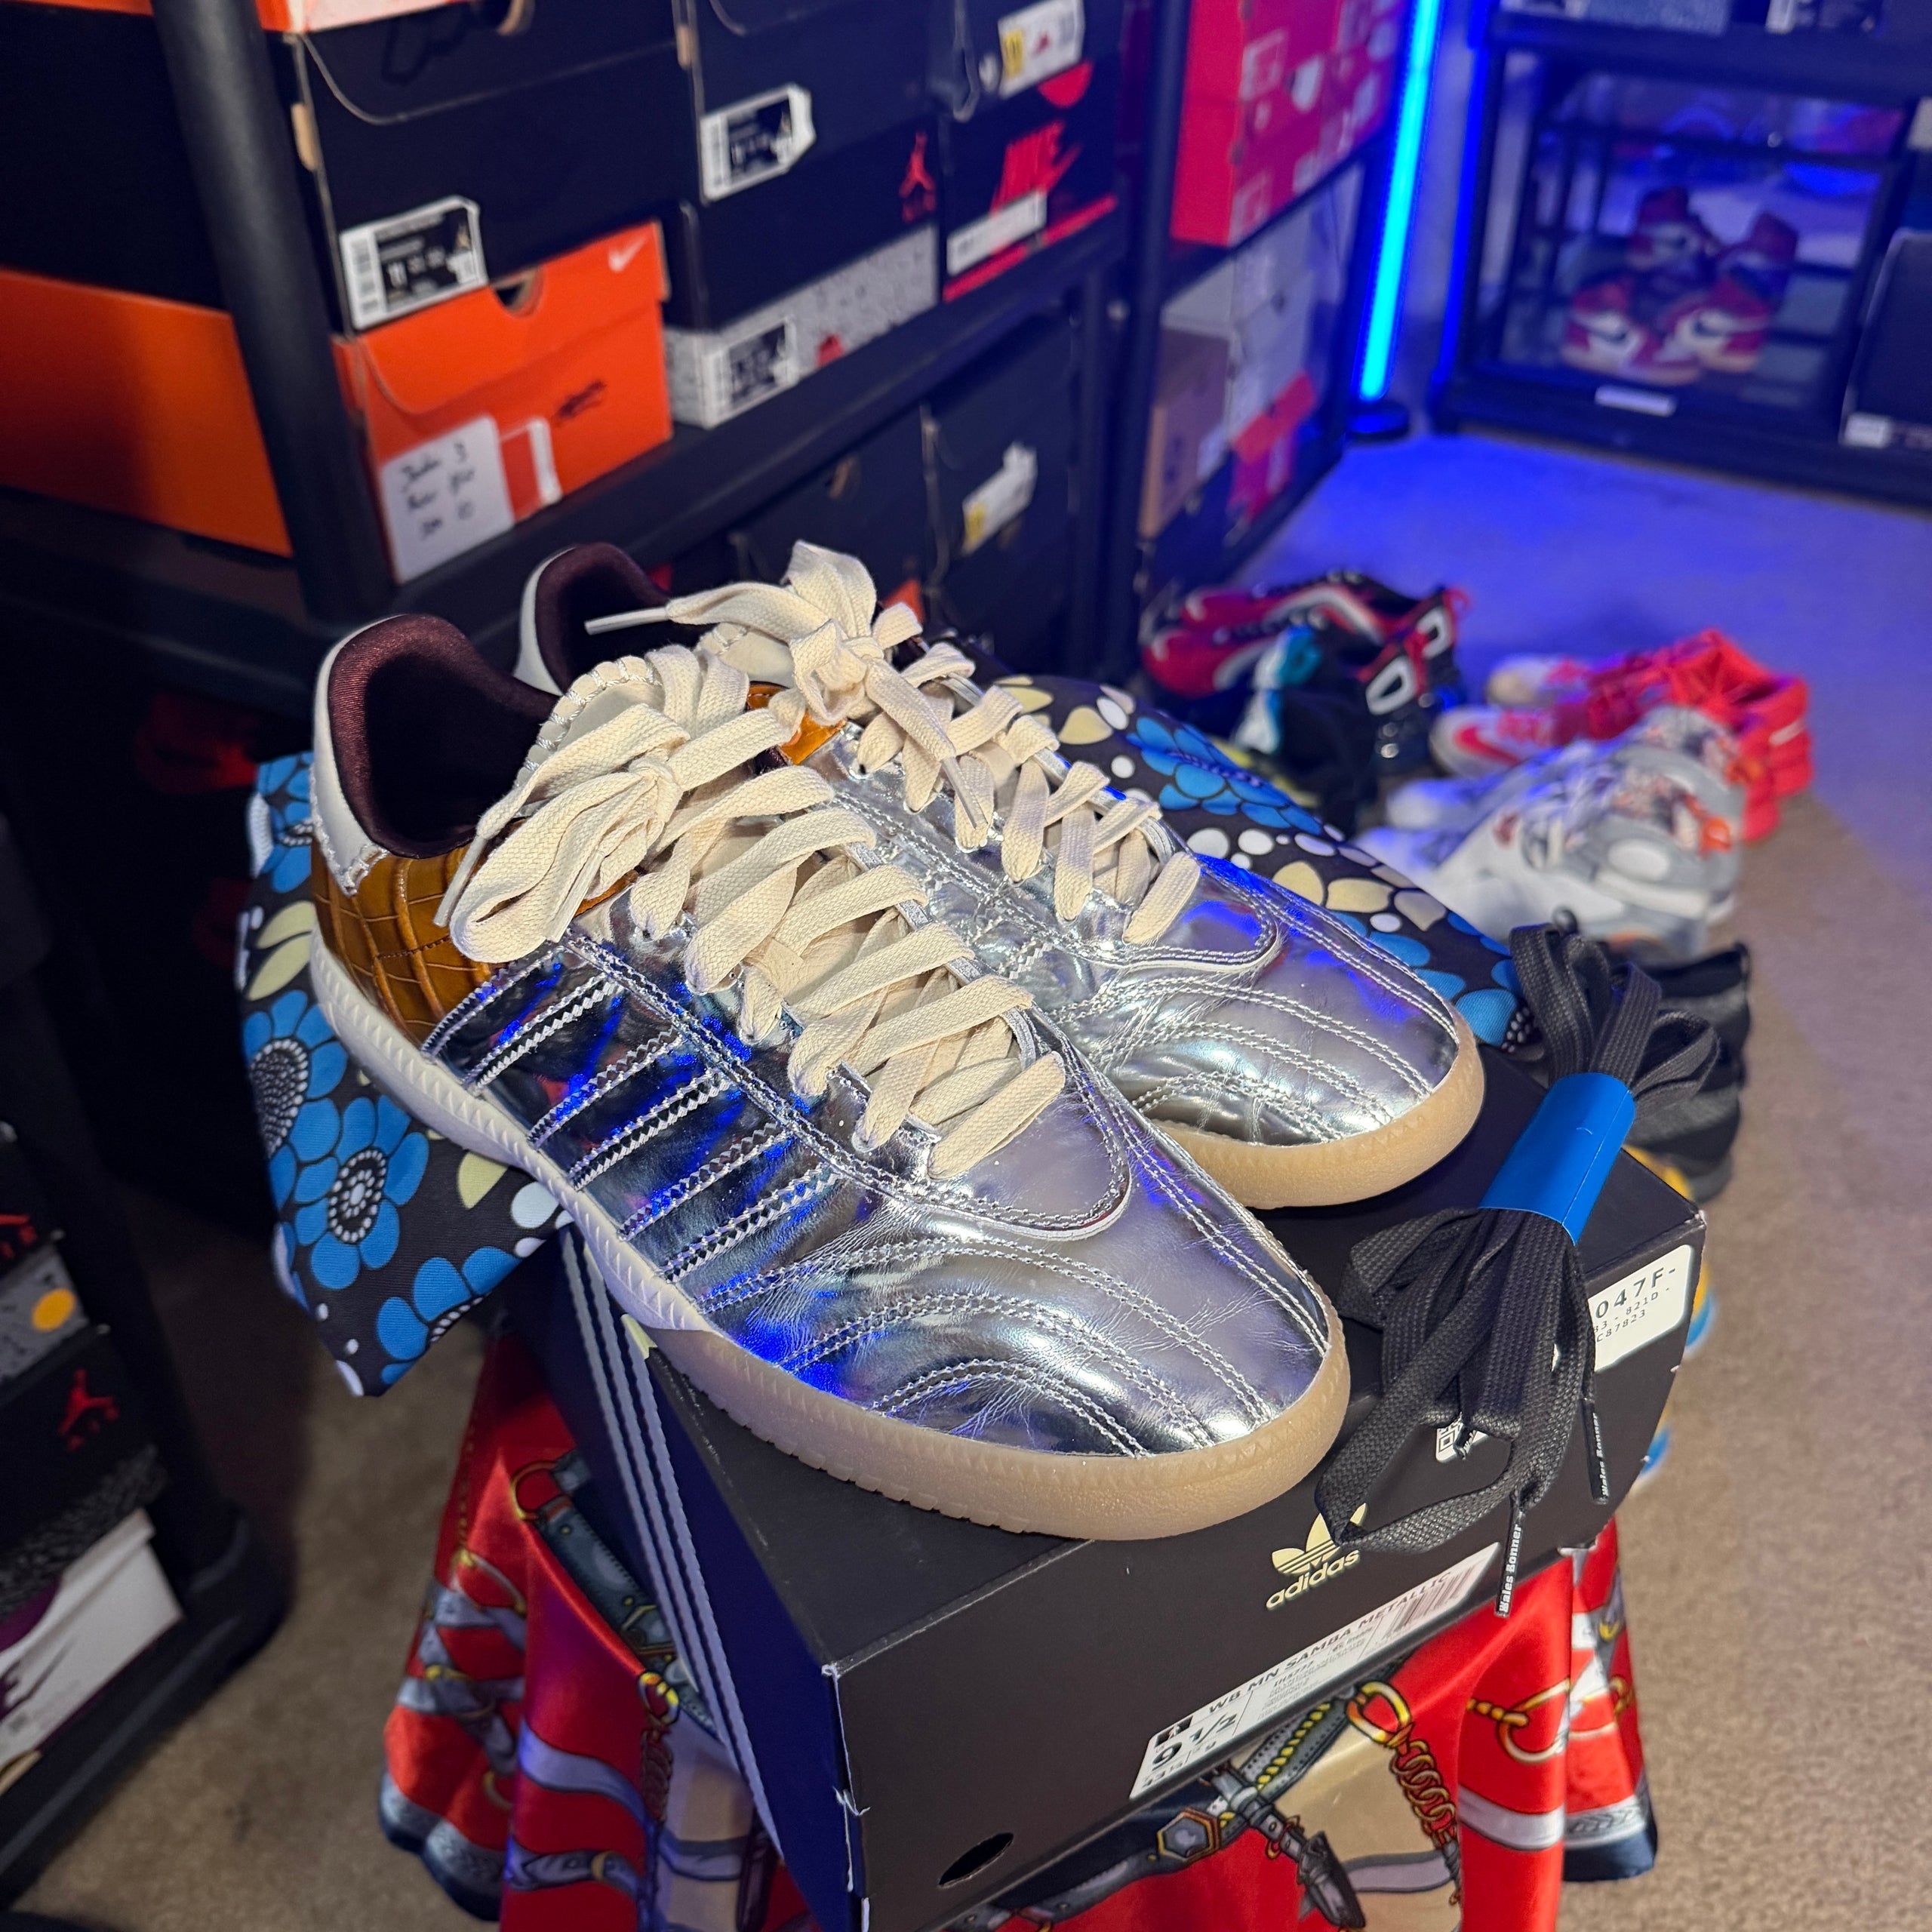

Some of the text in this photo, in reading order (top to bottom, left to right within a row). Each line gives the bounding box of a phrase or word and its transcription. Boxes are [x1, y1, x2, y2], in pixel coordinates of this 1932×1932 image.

[1596, 1309, 1645, 1343] C87823
[1266, 1549, 1360, 1609] adidas
[1499, 1524, 1522, 1613] Wales Bonner
[1209, 1690, 1241, 1713] WB
[1247, 1668, 1279, 1691] MN
[1284, 1627, 1351, 1670] SAMBA
[1358, 1571, 1451, 1629] METALLIC
[1152, 1712, 1238, 1771] 9 1/2
